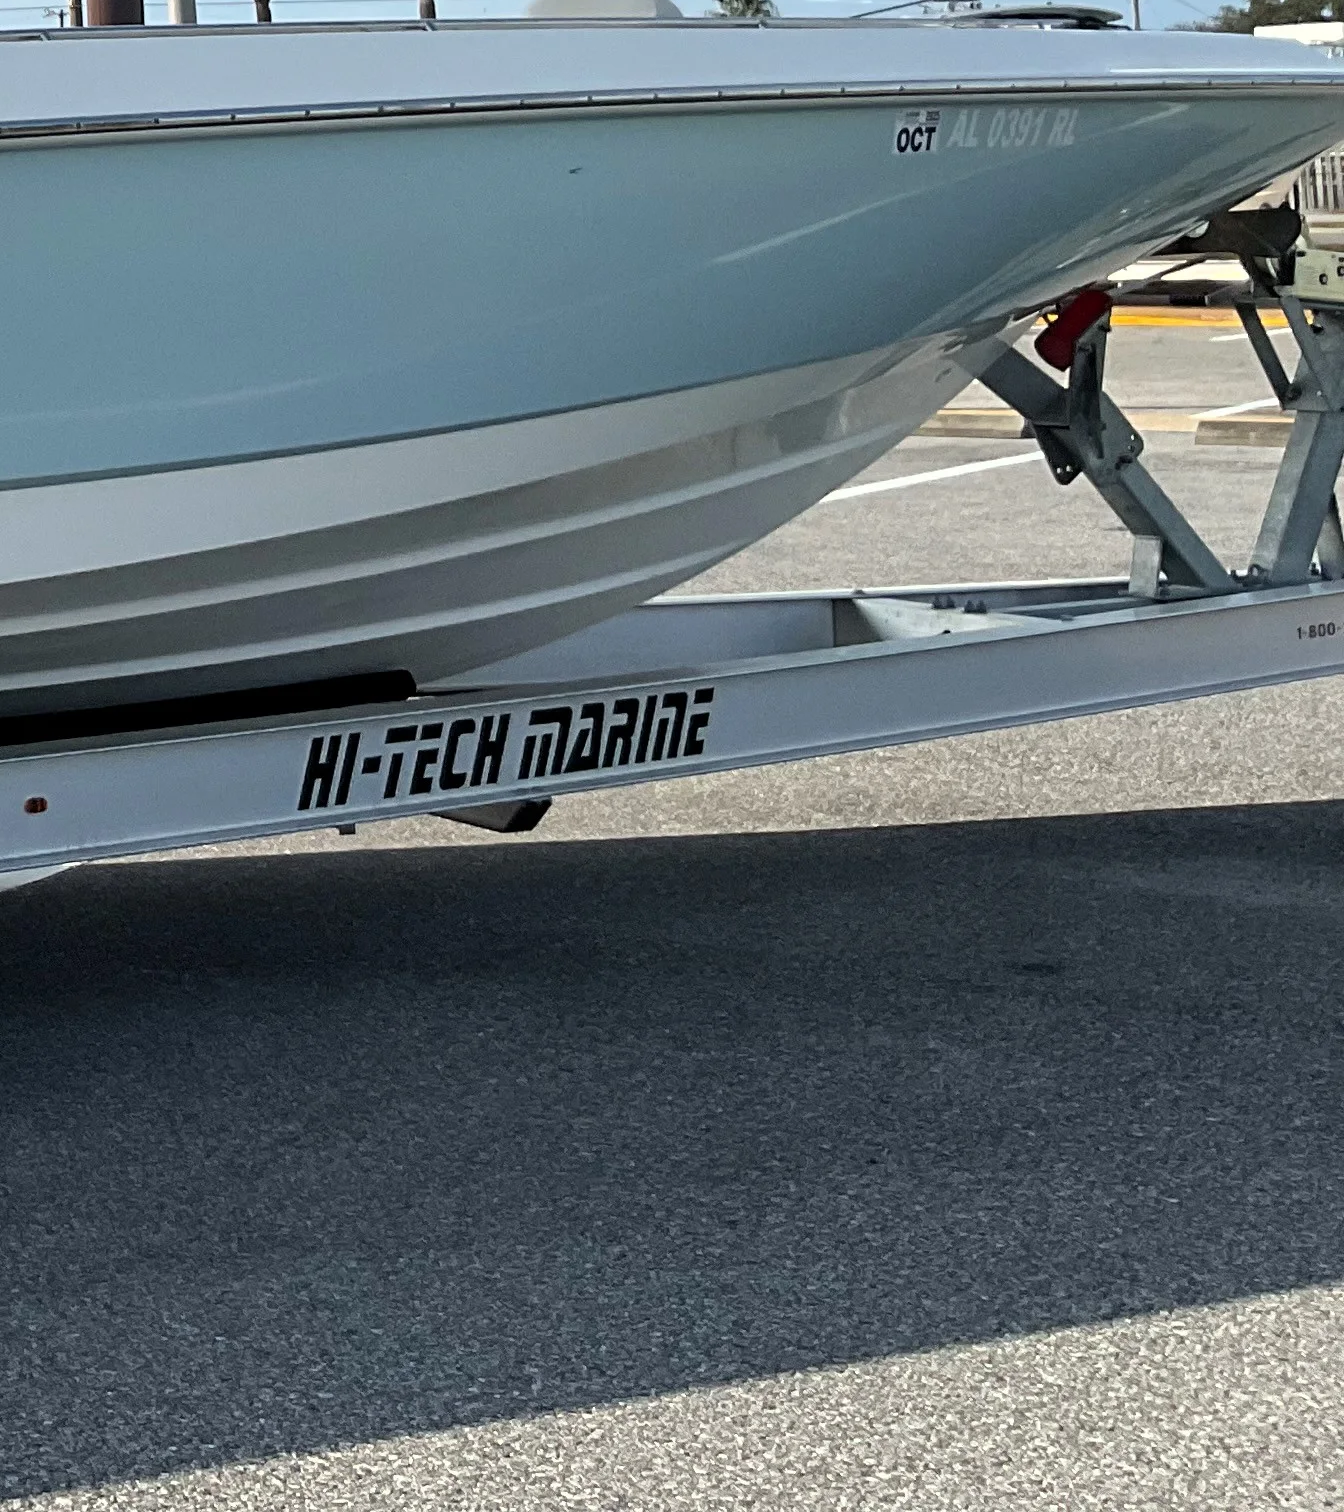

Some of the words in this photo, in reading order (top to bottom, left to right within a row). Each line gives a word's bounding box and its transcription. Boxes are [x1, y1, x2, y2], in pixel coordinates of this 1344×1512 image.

[896, 126, 937, 153] OCT
[946, 108, 981, 147] AL
[1296, 621, 1344, 639] 1-800-
[297, 712, 511, 811] HI-TECH
[517, 686, 715, 781] MARINE
